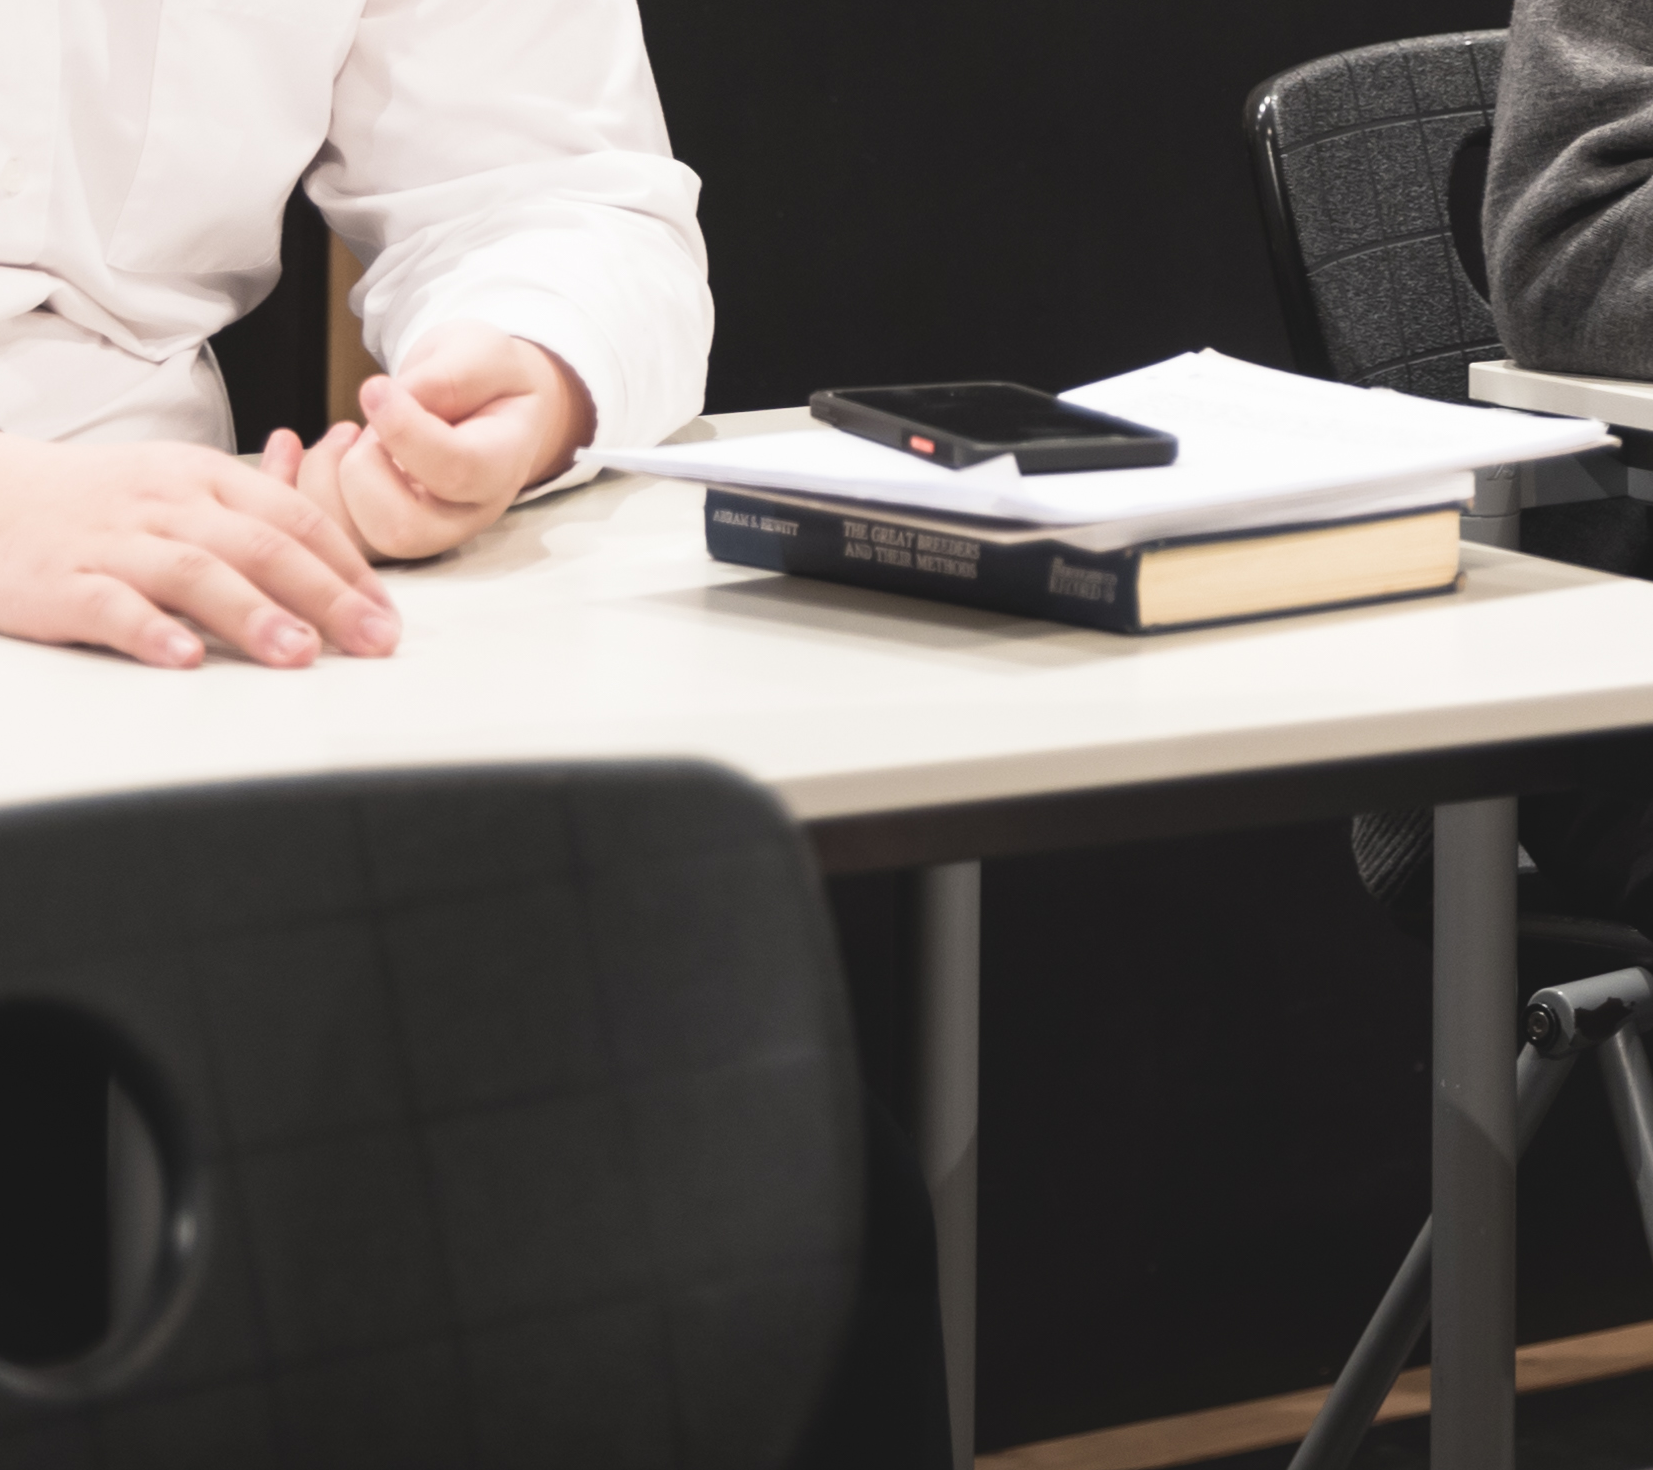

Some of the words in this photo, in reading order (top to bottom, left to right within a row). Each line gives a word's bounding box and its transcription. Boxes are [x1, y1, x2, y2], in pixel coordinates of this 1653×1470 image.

[843, 520, 869, 541] THE
[871, 525, 916, 549] GREAT
[917, 533, 981, 561] BREEDERS
[845, 541, 874, 561] AND
[875, 546, 913, 568] THEIR
[915, 552, 979, 580] METHODS
